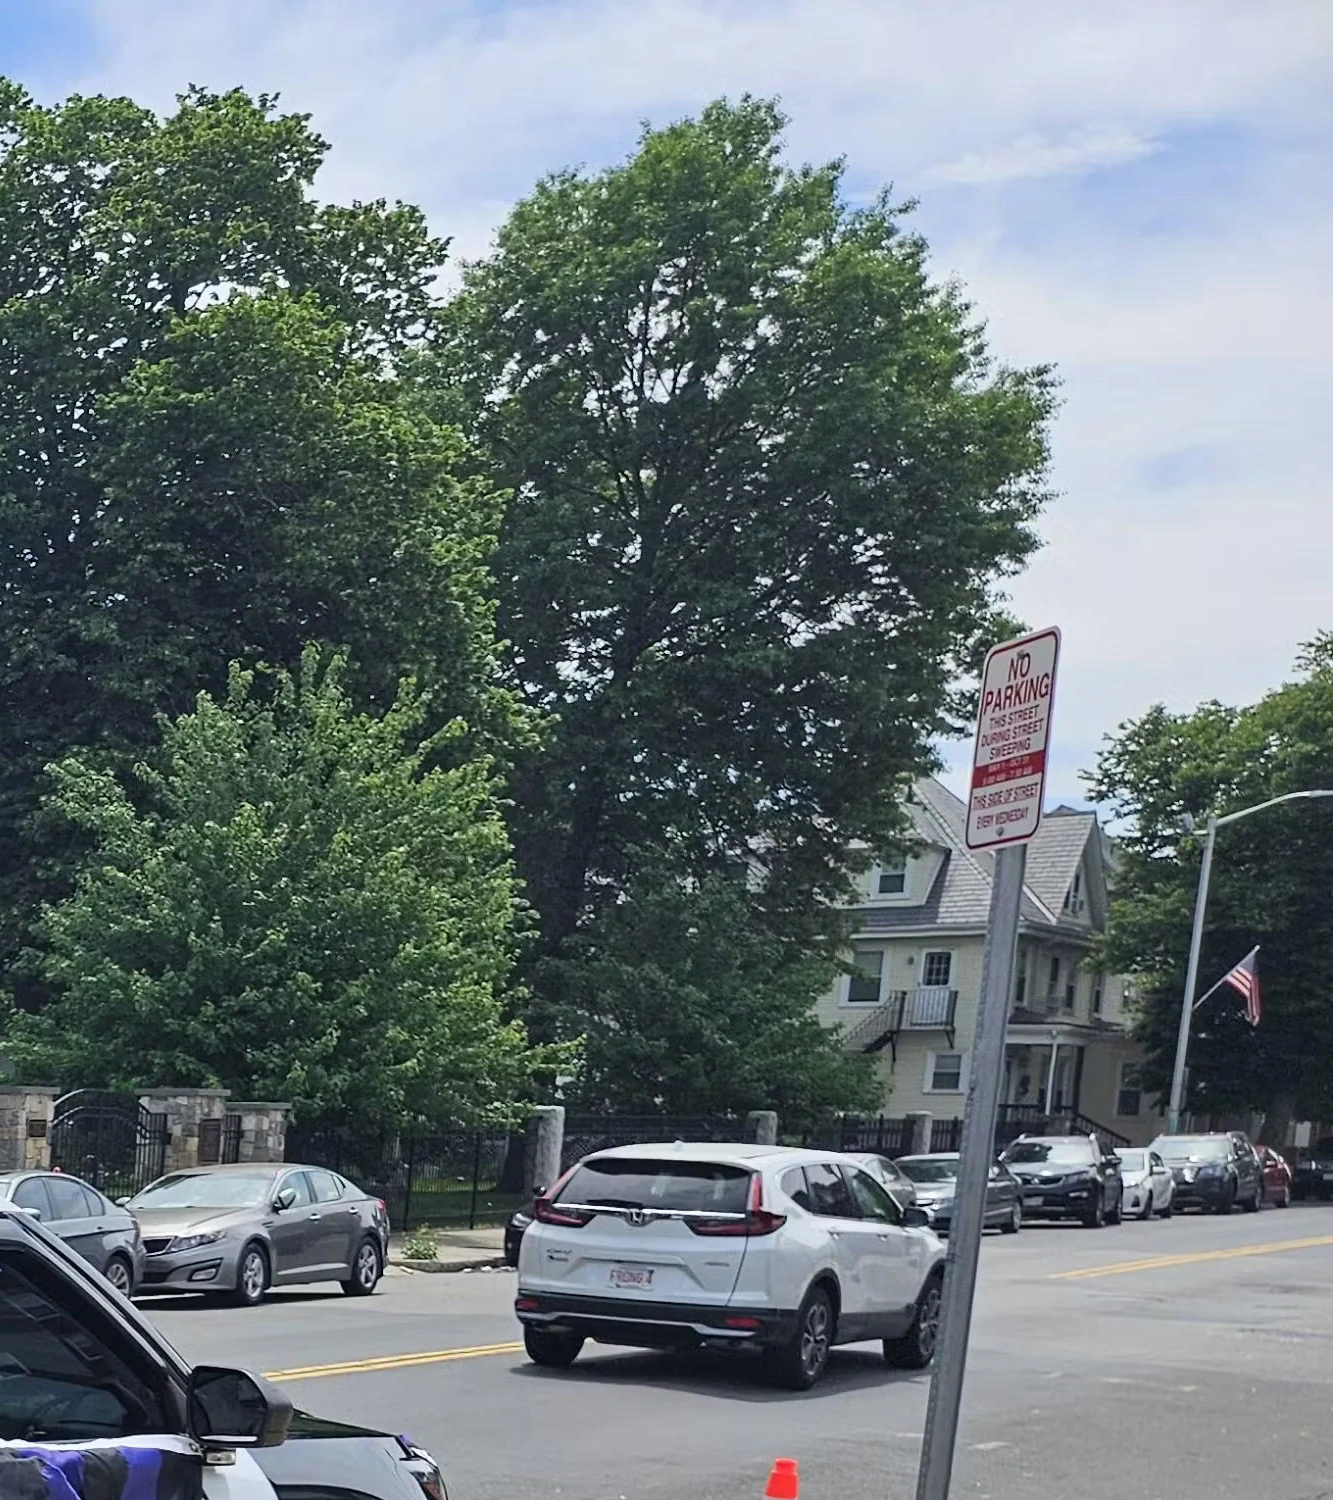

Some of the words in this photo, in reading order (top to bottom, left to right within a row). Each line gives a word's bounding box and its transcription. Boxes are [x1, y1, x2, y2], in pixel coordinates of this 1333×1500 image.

[1008, 652, 1031, 682] NO
[984, 673, 1050, 715] PARKING
[990, 714, 1007, 730] THIS
[1008, 703, 1041, 726] STREET
[980, 728, 1011, 748] DURING
[1012, 717, 1044, 739] STREET
[989, 737, 1032, 760] SWEEPING
